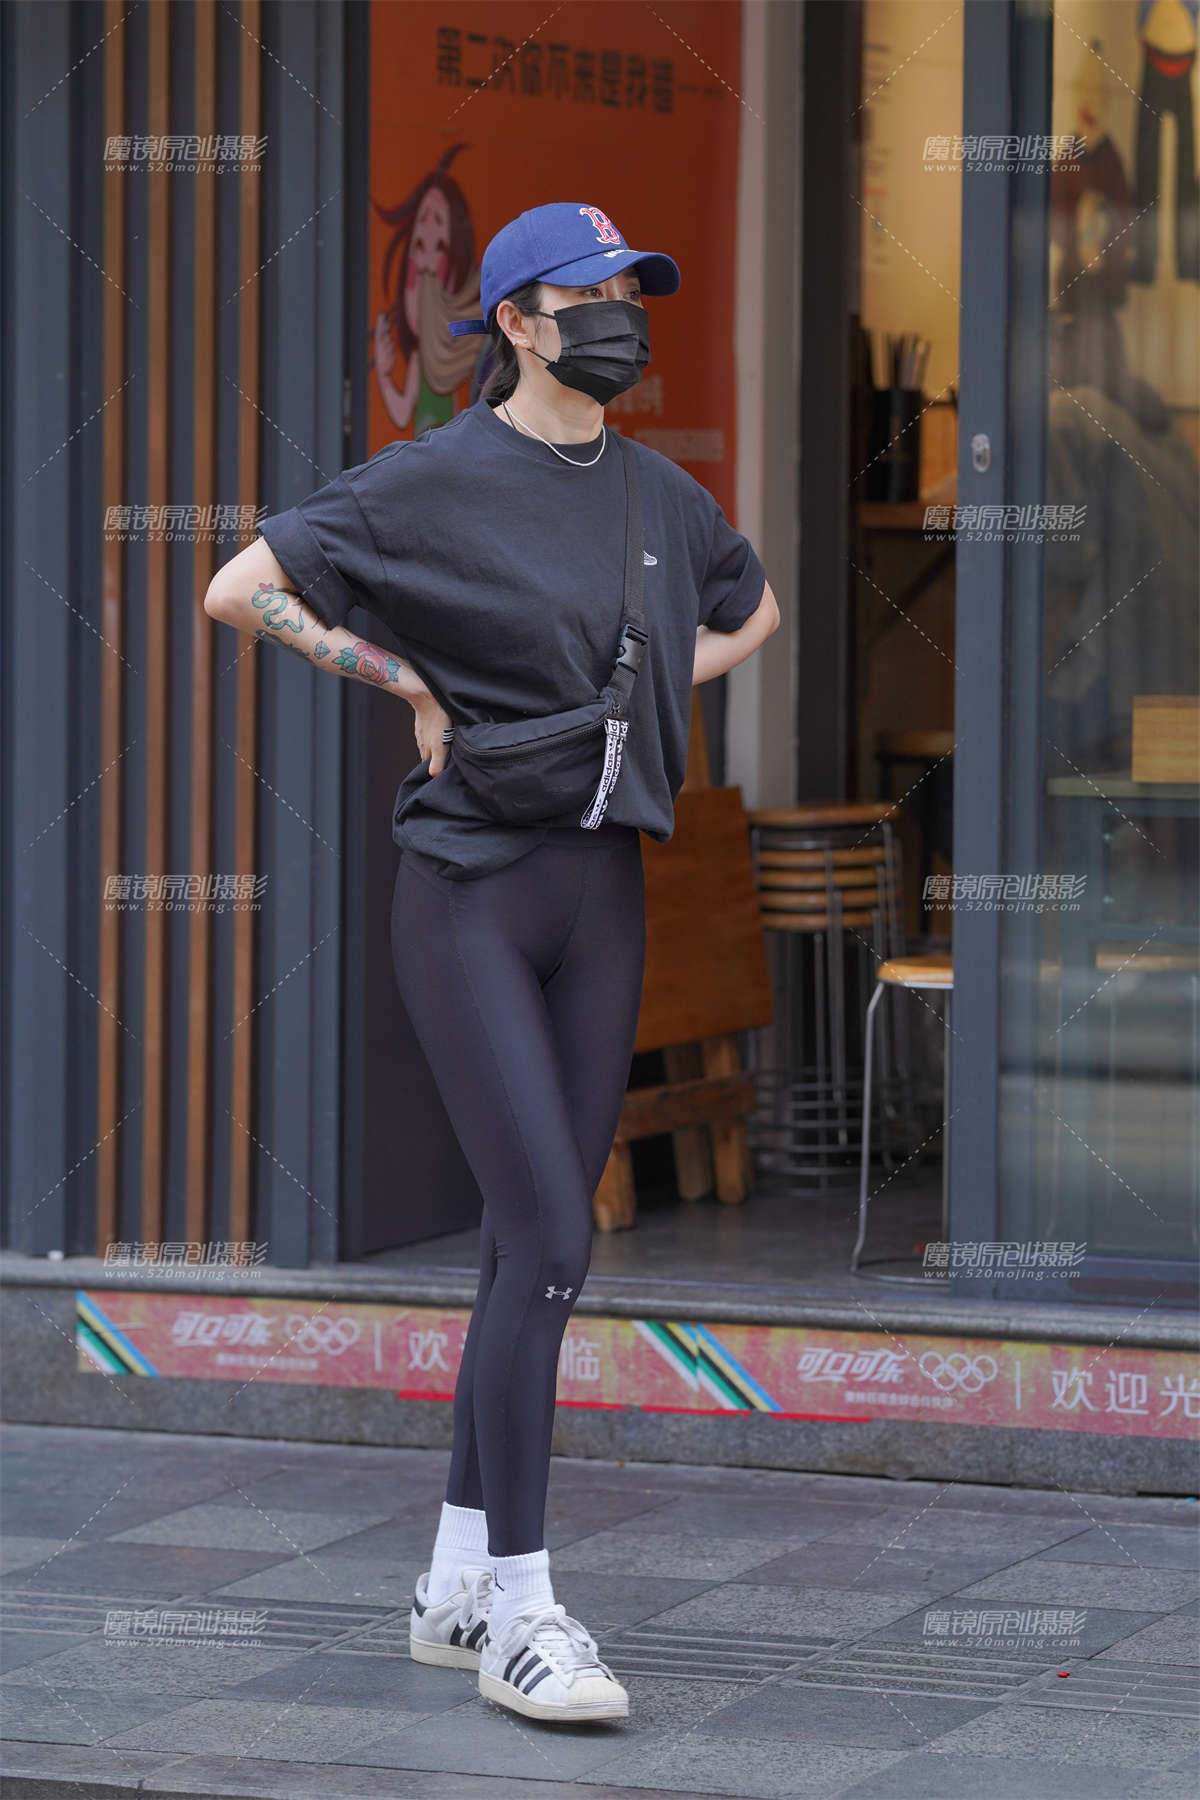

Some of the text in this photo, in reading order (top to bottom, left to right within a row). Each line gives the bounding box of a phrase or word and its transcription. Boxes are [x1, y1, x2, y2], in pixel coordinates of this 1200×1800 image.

[579, 207, 621, 244] B
[601, 753, 614, 793] adidas
[171, 1311, 276, 1347] 可口可乐
[797, 1347, 908, 1384] 可口可乐
